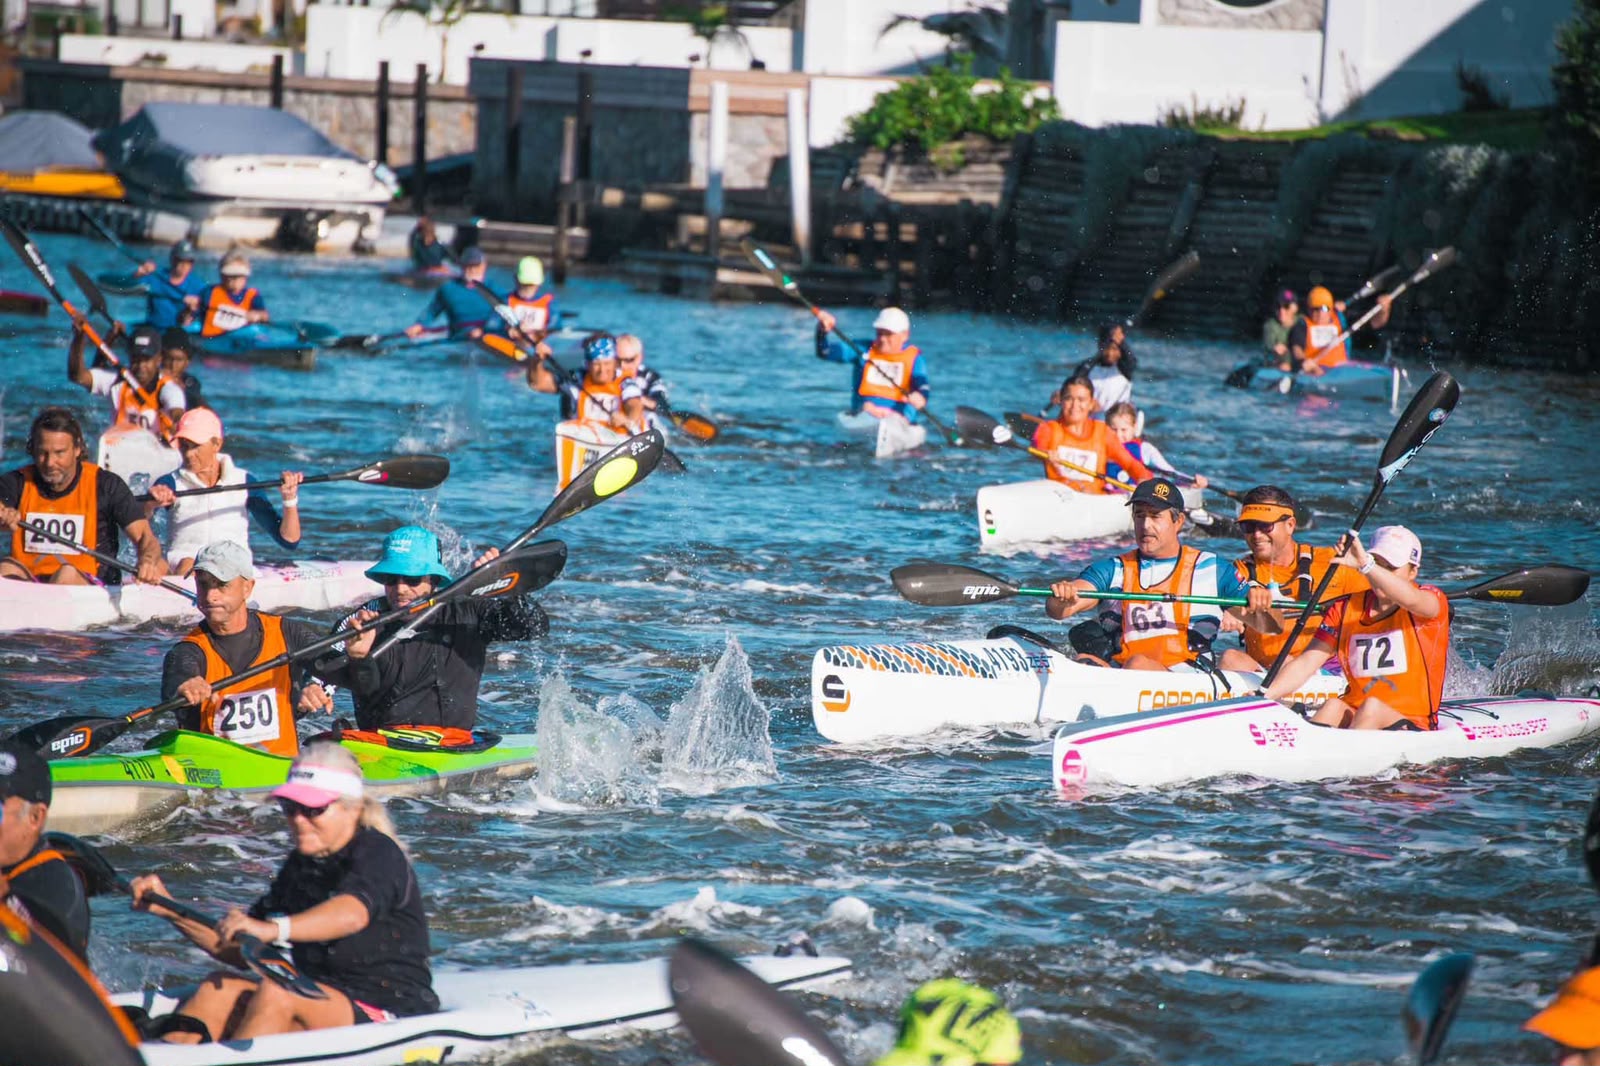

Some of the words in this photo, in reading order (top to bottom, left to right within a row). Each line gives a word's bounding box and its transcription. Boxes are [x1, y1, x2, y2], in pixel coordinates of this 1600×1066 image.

[30, 518, 76, 543] 209
[962, 585, 1000, 599] epic
[1131, 602, 1168, 633] 63
[1355, 637, 1394, 670] 72
[220, 694, 272, 731] 250
[51, 733, 84, 753] epic
